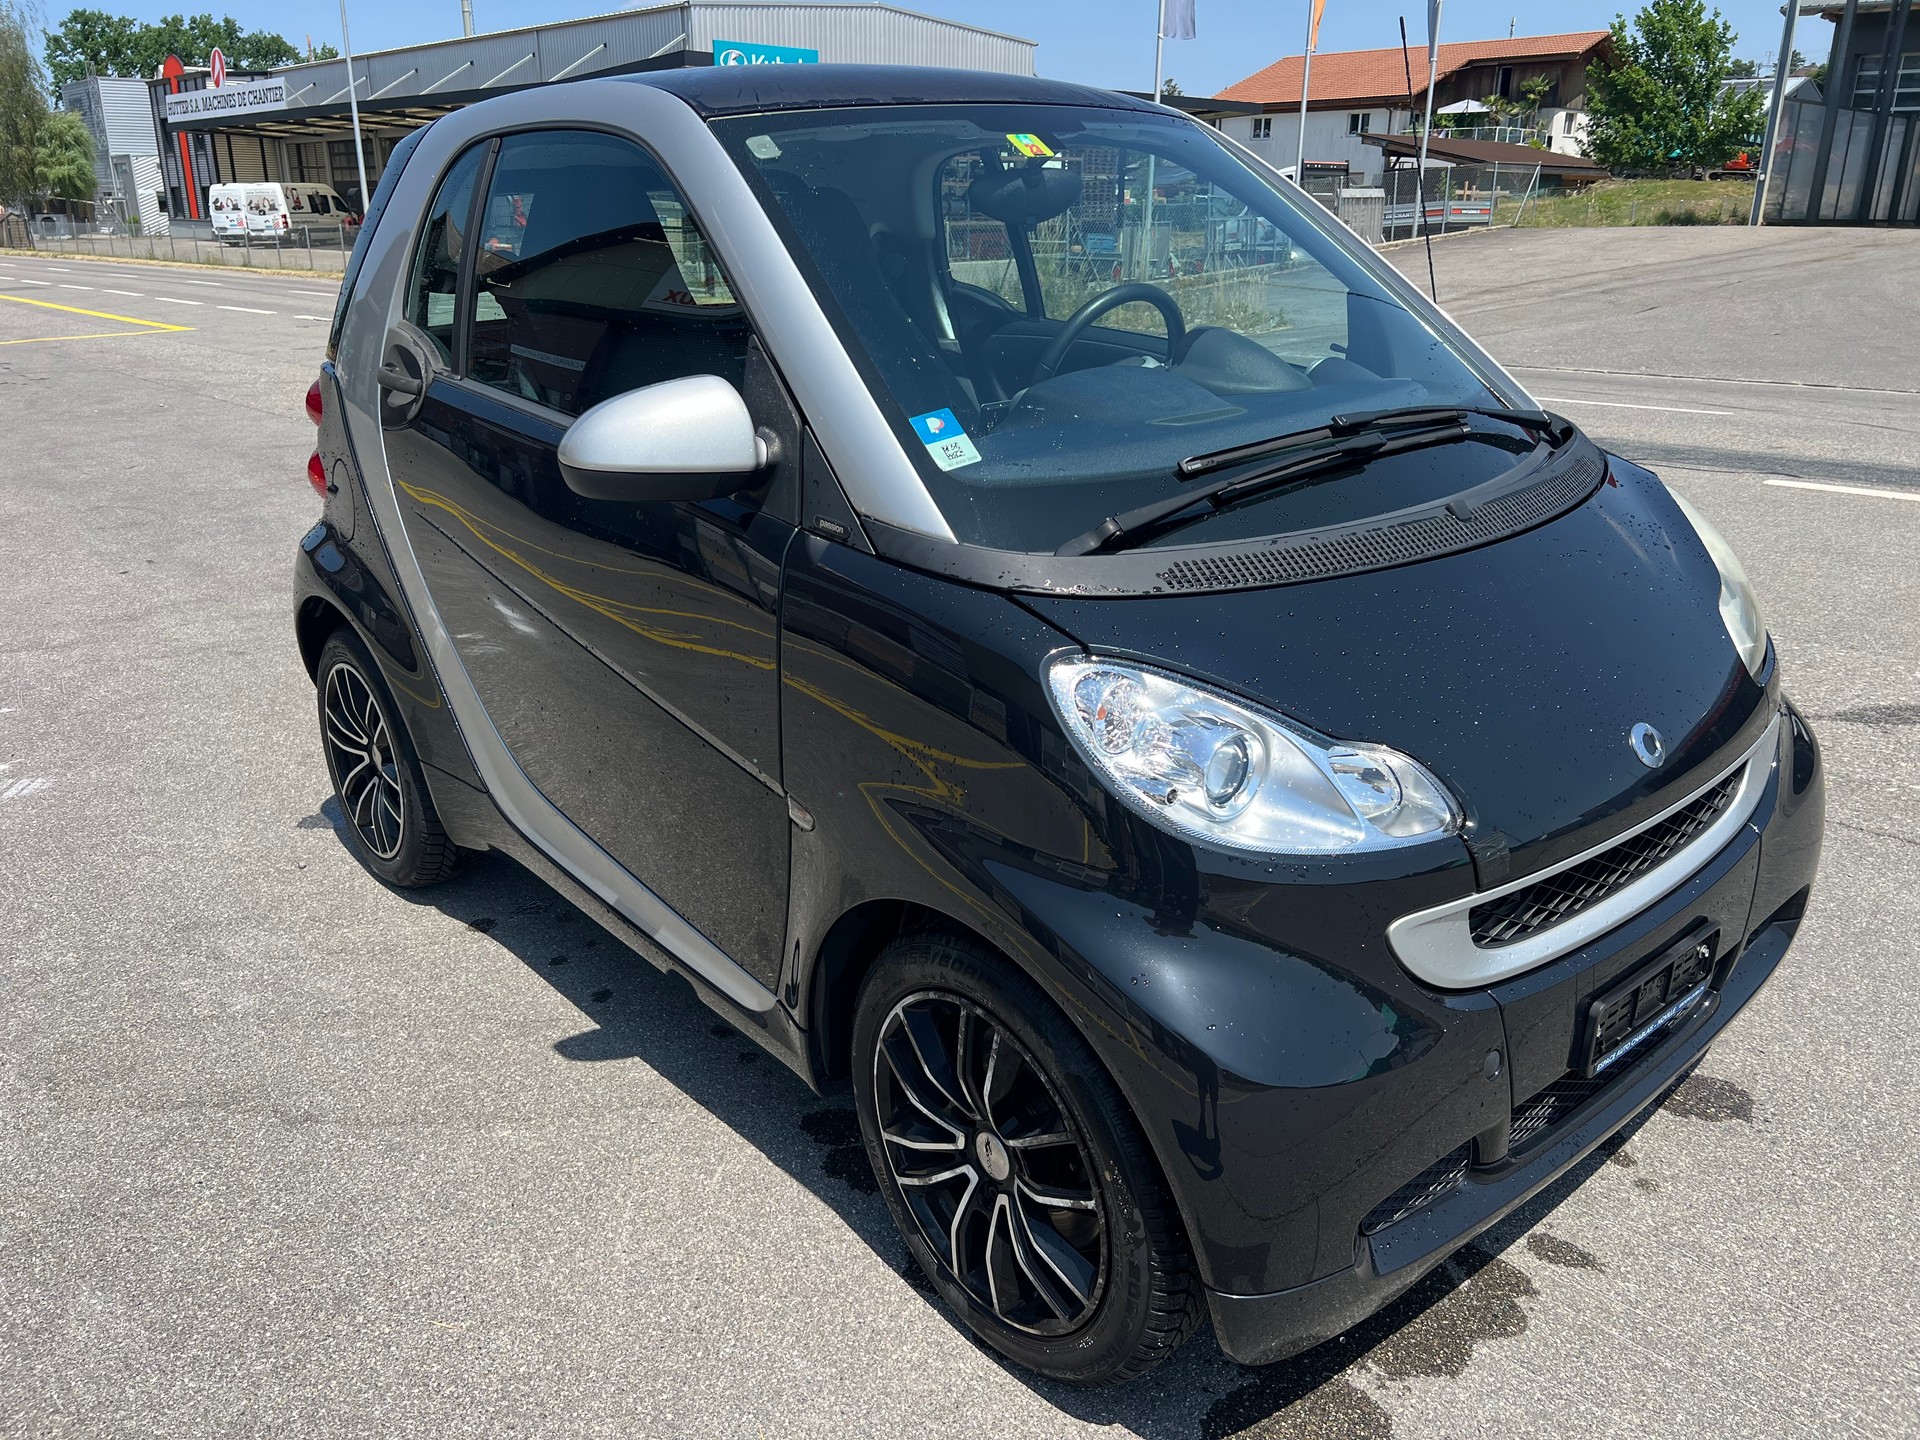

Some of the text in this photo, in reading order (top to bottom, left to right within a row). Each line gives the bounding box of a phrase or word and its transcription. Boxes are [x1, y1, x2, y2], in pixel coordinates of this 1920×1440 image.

[168, 86, 285, 116] HUTTER S.A. MACHINES DE CHANTIER
[819, 519, 844, 534] passion
[1596, 1053, 1616, 1072] ESPACE
[1616, 1042, 1631, 1057] AUTO
